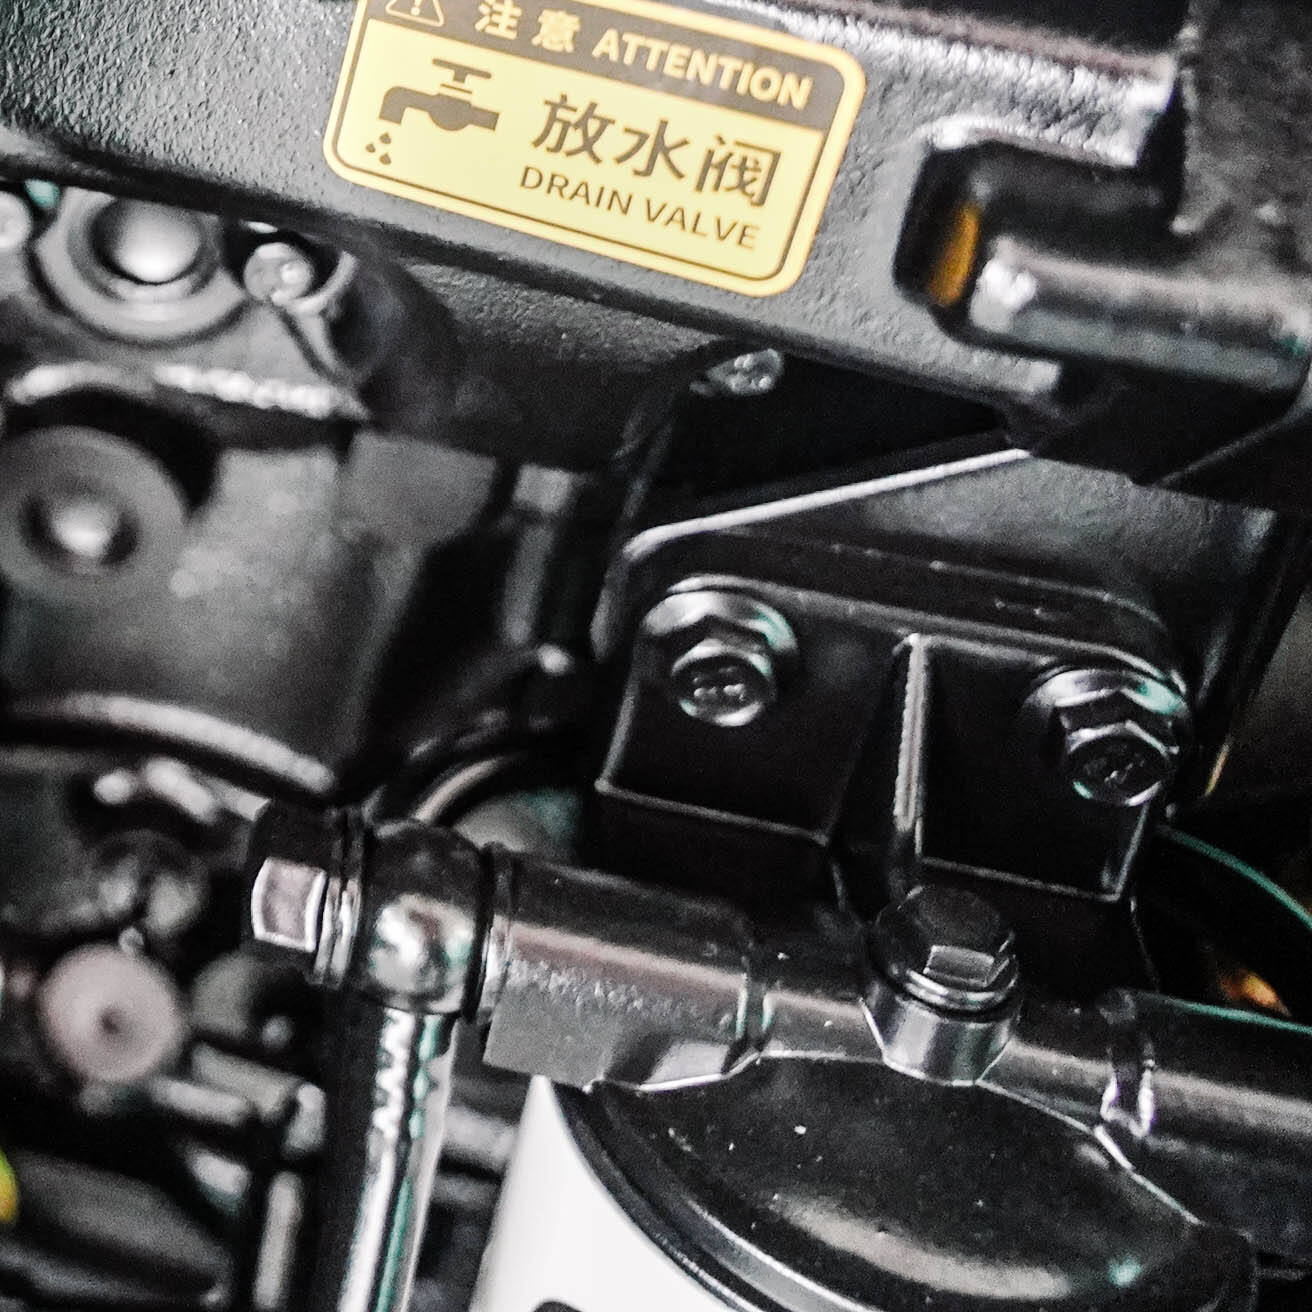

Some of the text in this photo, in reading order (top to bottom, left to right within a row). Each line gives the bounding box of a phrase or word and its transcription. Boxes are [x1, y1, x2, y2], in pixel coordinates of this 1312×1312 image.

[592, 28, 814, 110] ATTENTION
[532, 94, 782, 207] 放水阀
[519, 164, 762, 251] DRAIN VALVE
